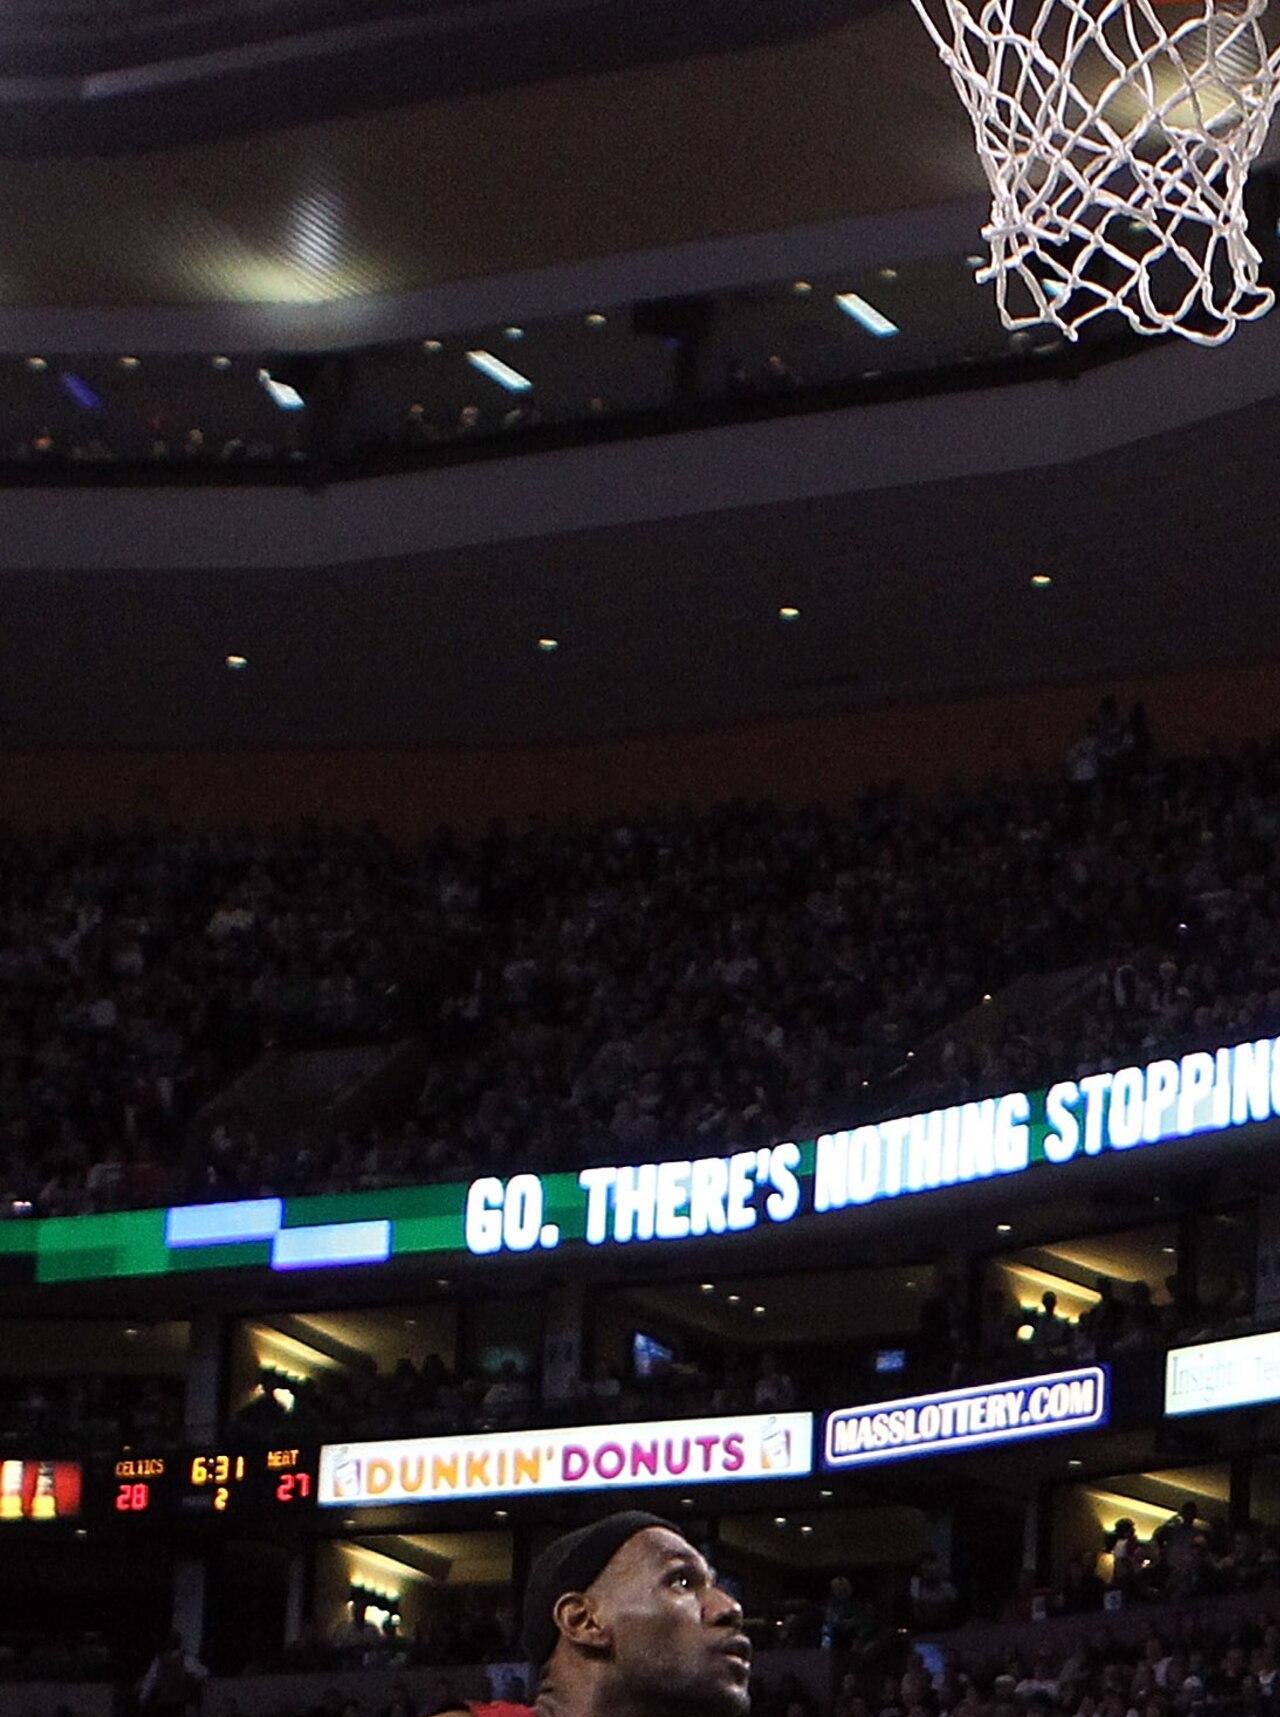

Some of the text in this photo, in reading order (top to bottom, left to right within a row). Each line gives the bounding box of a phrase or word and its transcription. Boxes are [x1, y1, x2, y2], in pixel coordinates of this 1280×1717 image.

[466, 1175, 560, 1254] GO.
[579, 1142, 800, 1245] THERE'S
[814, 1092, 1031, 1213] NOTHING
[834, 1378, 1095, 1455] MASSLOTTERY.COM
[115, 1459, 164, 1477] CELTICS
[191, 1455, 244, 1484] 6:31
[365, 1432, 745, 1495] DUNKIN' DONUTS
[116, 1483, 149, 1511] 28
[214, 1487, 229, 1511] 2
[276, 1473, 311, 1501] 27
